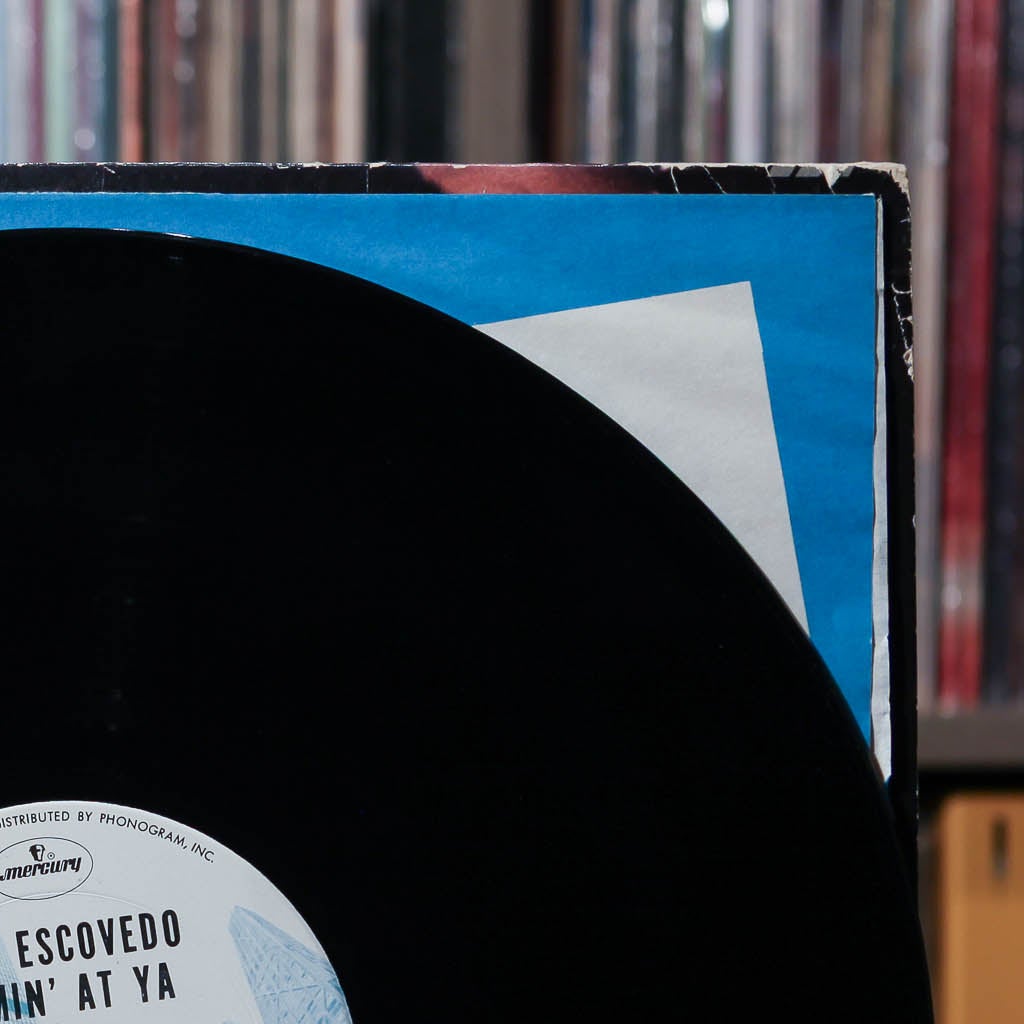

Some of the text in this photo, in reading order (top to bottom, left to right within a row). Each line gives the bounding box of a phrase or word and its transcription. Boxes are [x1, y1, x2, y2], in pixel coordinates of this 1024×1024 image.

[78, 811, 93, 822] BY
[99, 813, 188, 849] PHONOGRAM,
[191, 842, 215, 864] INC.
[0, 857, 82, 881] mercury
[15, 909, 182, 969] ESCOVEDO
[78, 970, 112, 1011] AT
[133, 962, 176, 1003] YA
